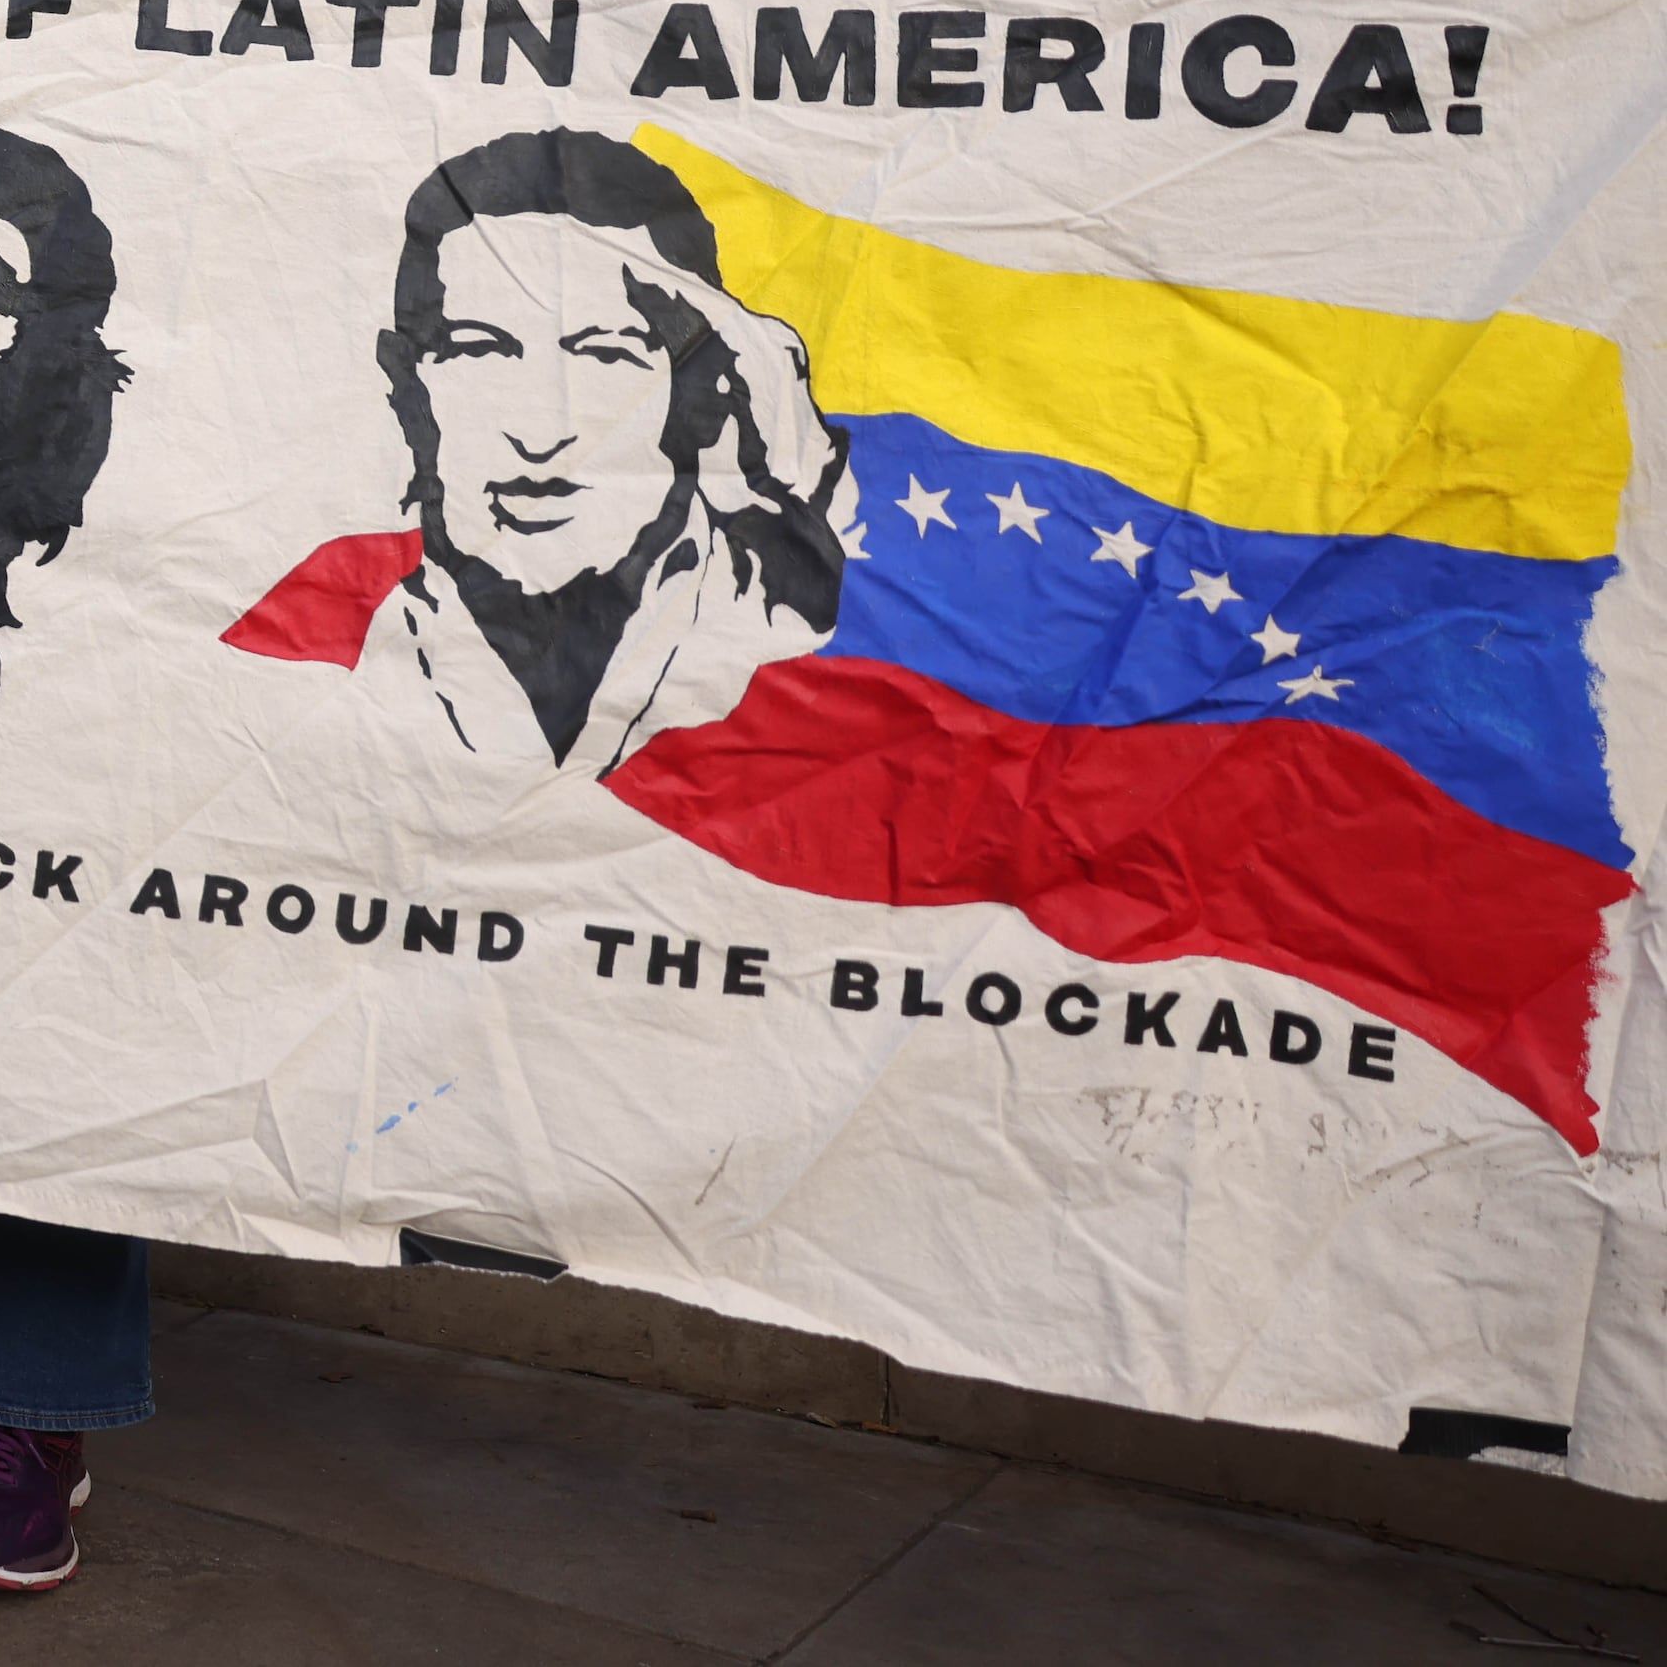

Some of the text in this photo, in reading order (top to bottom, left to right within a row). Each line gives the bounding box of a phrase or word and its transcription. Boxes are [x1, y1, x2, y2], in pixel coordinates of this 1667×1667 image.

[629, 2, 1490, 137] AMERICA!
[129, 867, 525, 963] AROUND
[584, 924, 770, 999] THE
[829, 958, 1397, 1082] BLOCKADE
